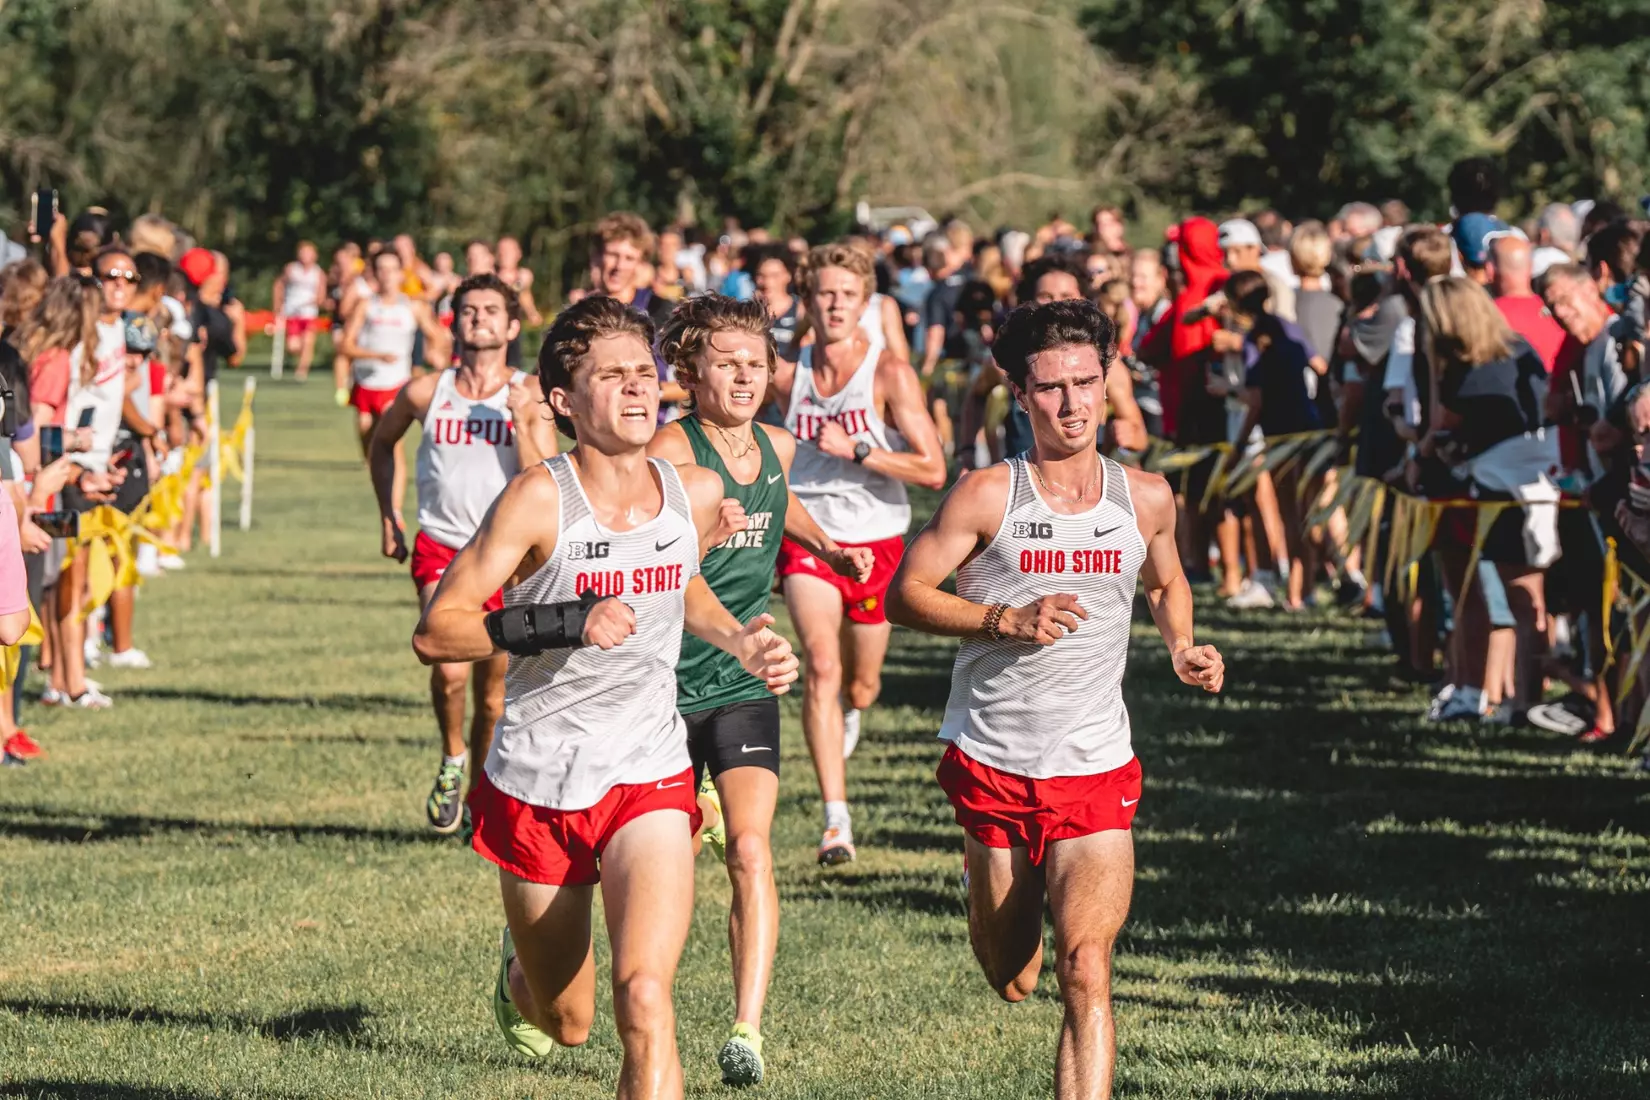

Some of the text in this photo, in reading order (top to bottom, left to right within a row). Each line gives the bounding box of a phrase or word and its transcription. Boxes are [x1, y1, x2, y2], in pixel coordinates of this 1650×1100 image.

[716, 530, 765, 549] TATE
[1020, 549, 1123, 573] OHIO STATE
[575, 563, 684, 598] OHIO STATE
